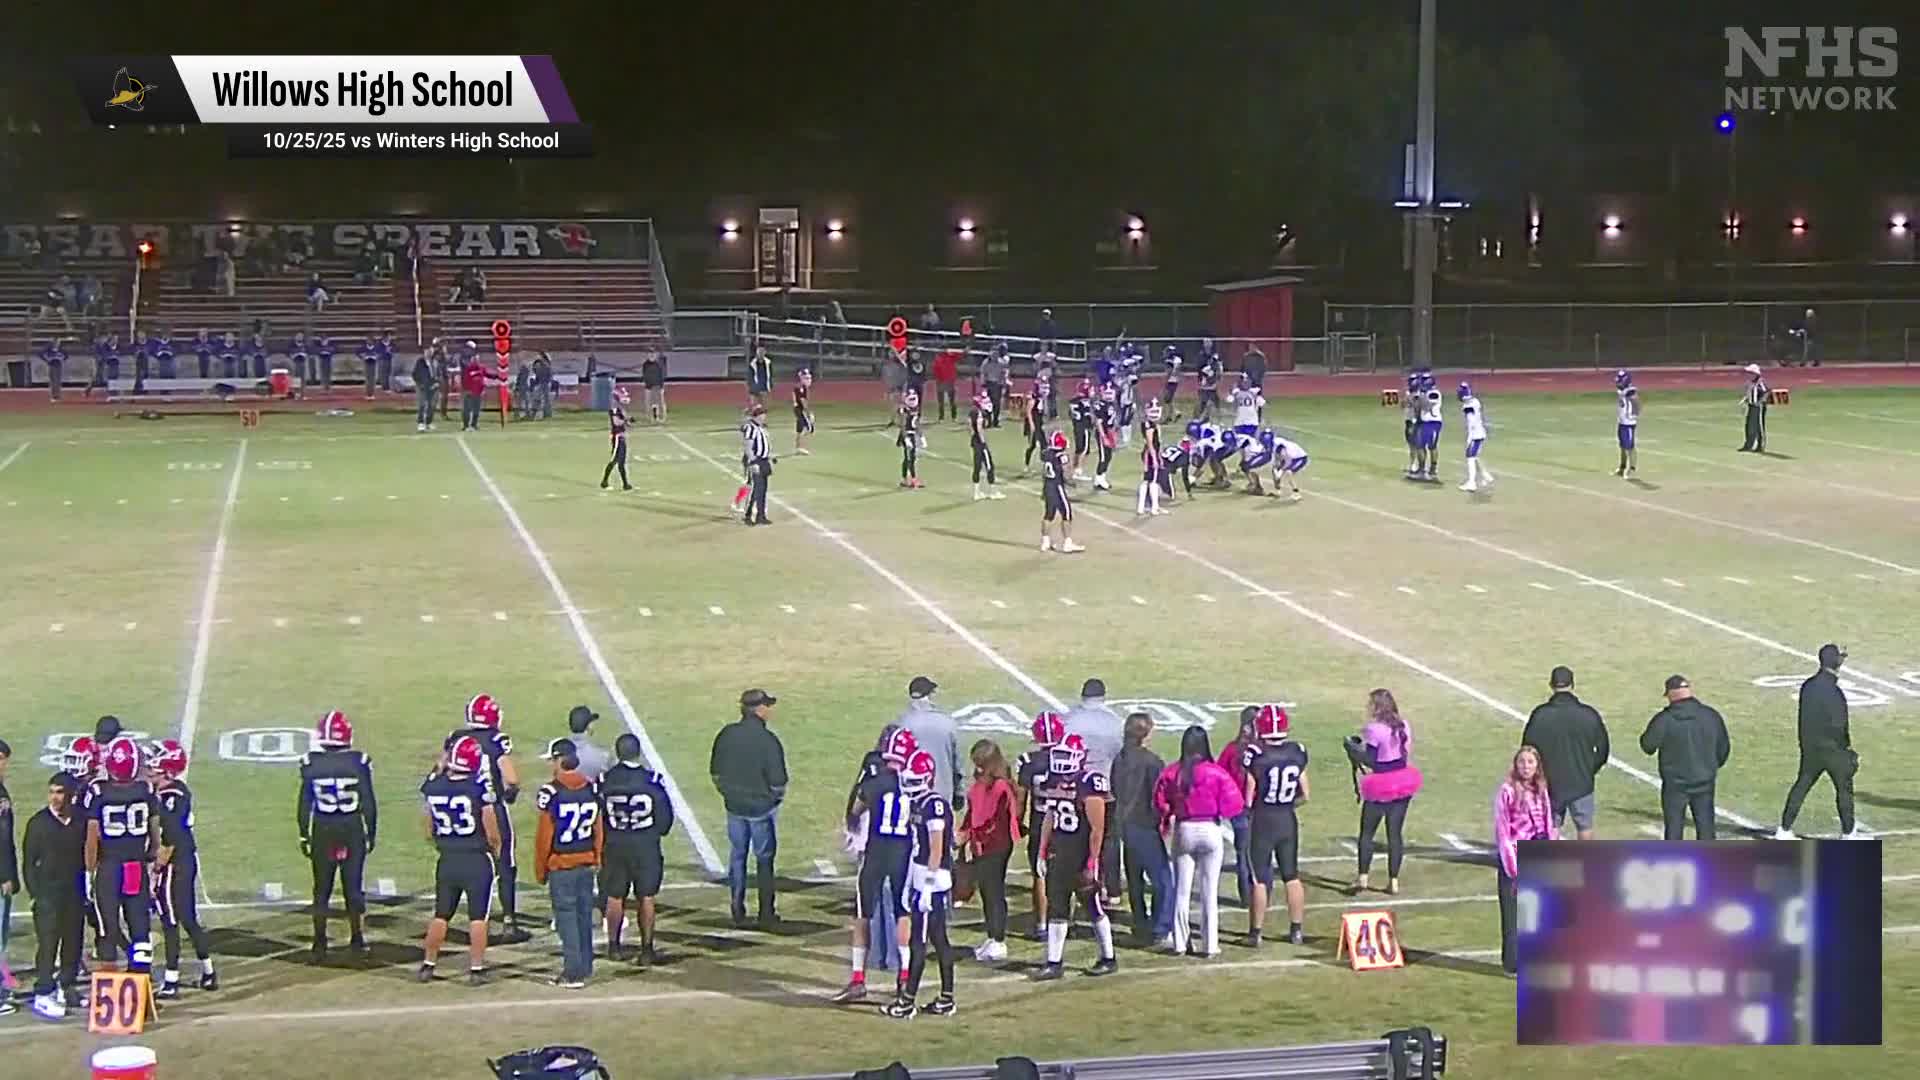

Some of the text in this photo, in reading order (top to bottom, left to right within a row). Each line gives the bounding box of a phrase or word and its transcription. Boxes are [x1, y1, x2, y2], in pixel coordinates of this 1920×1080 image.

[333, 224, 541, 256] SPEAR
[242, 411, 257, 426] 50
[312, 777, 359, 813] 55
[1263, 765, 1300, 804] 16
[427, 795, 477, 835] 53
[559, 801, 599, 843] 72
[879, 792, 911, 836] 11
[934, 801, 945, 816] 8
[1355, 917, 1397, 964] 40
[95, 976, 139, 1028] 50
